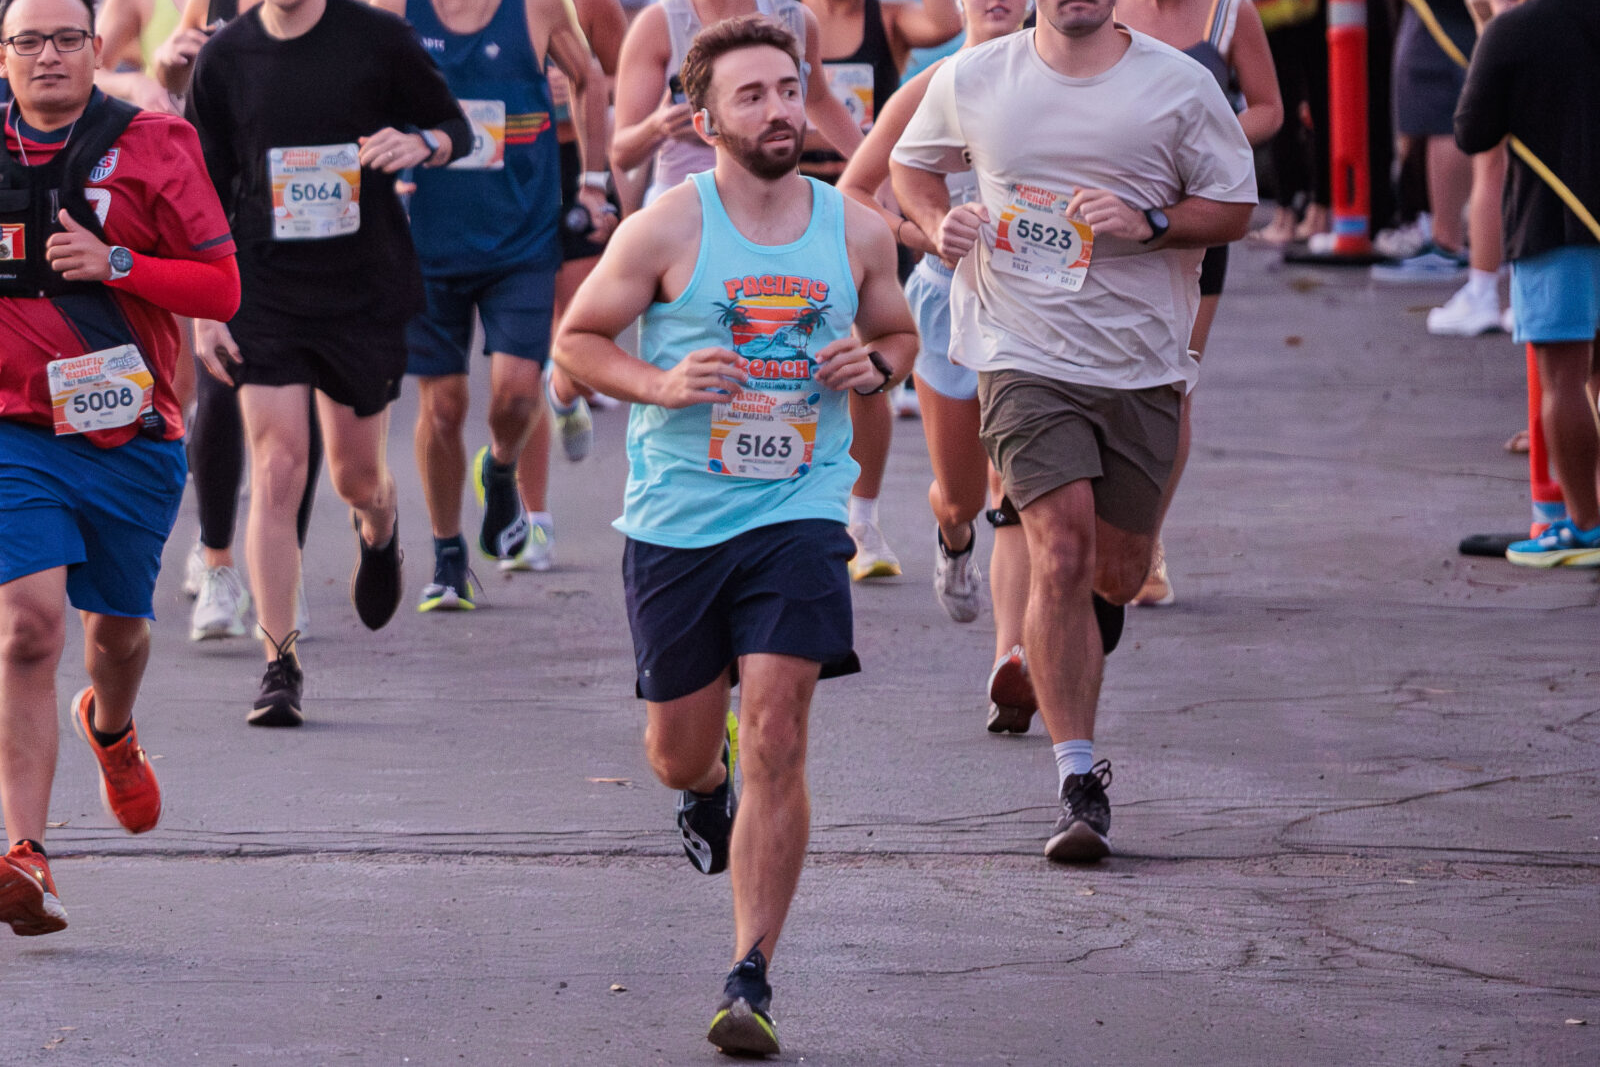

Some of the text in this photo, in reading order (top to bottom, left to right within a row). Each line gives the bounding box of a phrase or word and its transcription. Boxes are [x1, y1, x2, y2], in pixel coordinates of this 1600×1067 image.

[291, 182, 342, 202] 5064
[1016, 219, 1072, 250] 5523
[723, 274, 830, 302] PACIFIC
[60, 357, 105, 372] PACIFIC
[73, 387, 133, 413] 5008
[732, 402, 771, 414] BEACH
[736, 433, 792, 458] 5163
